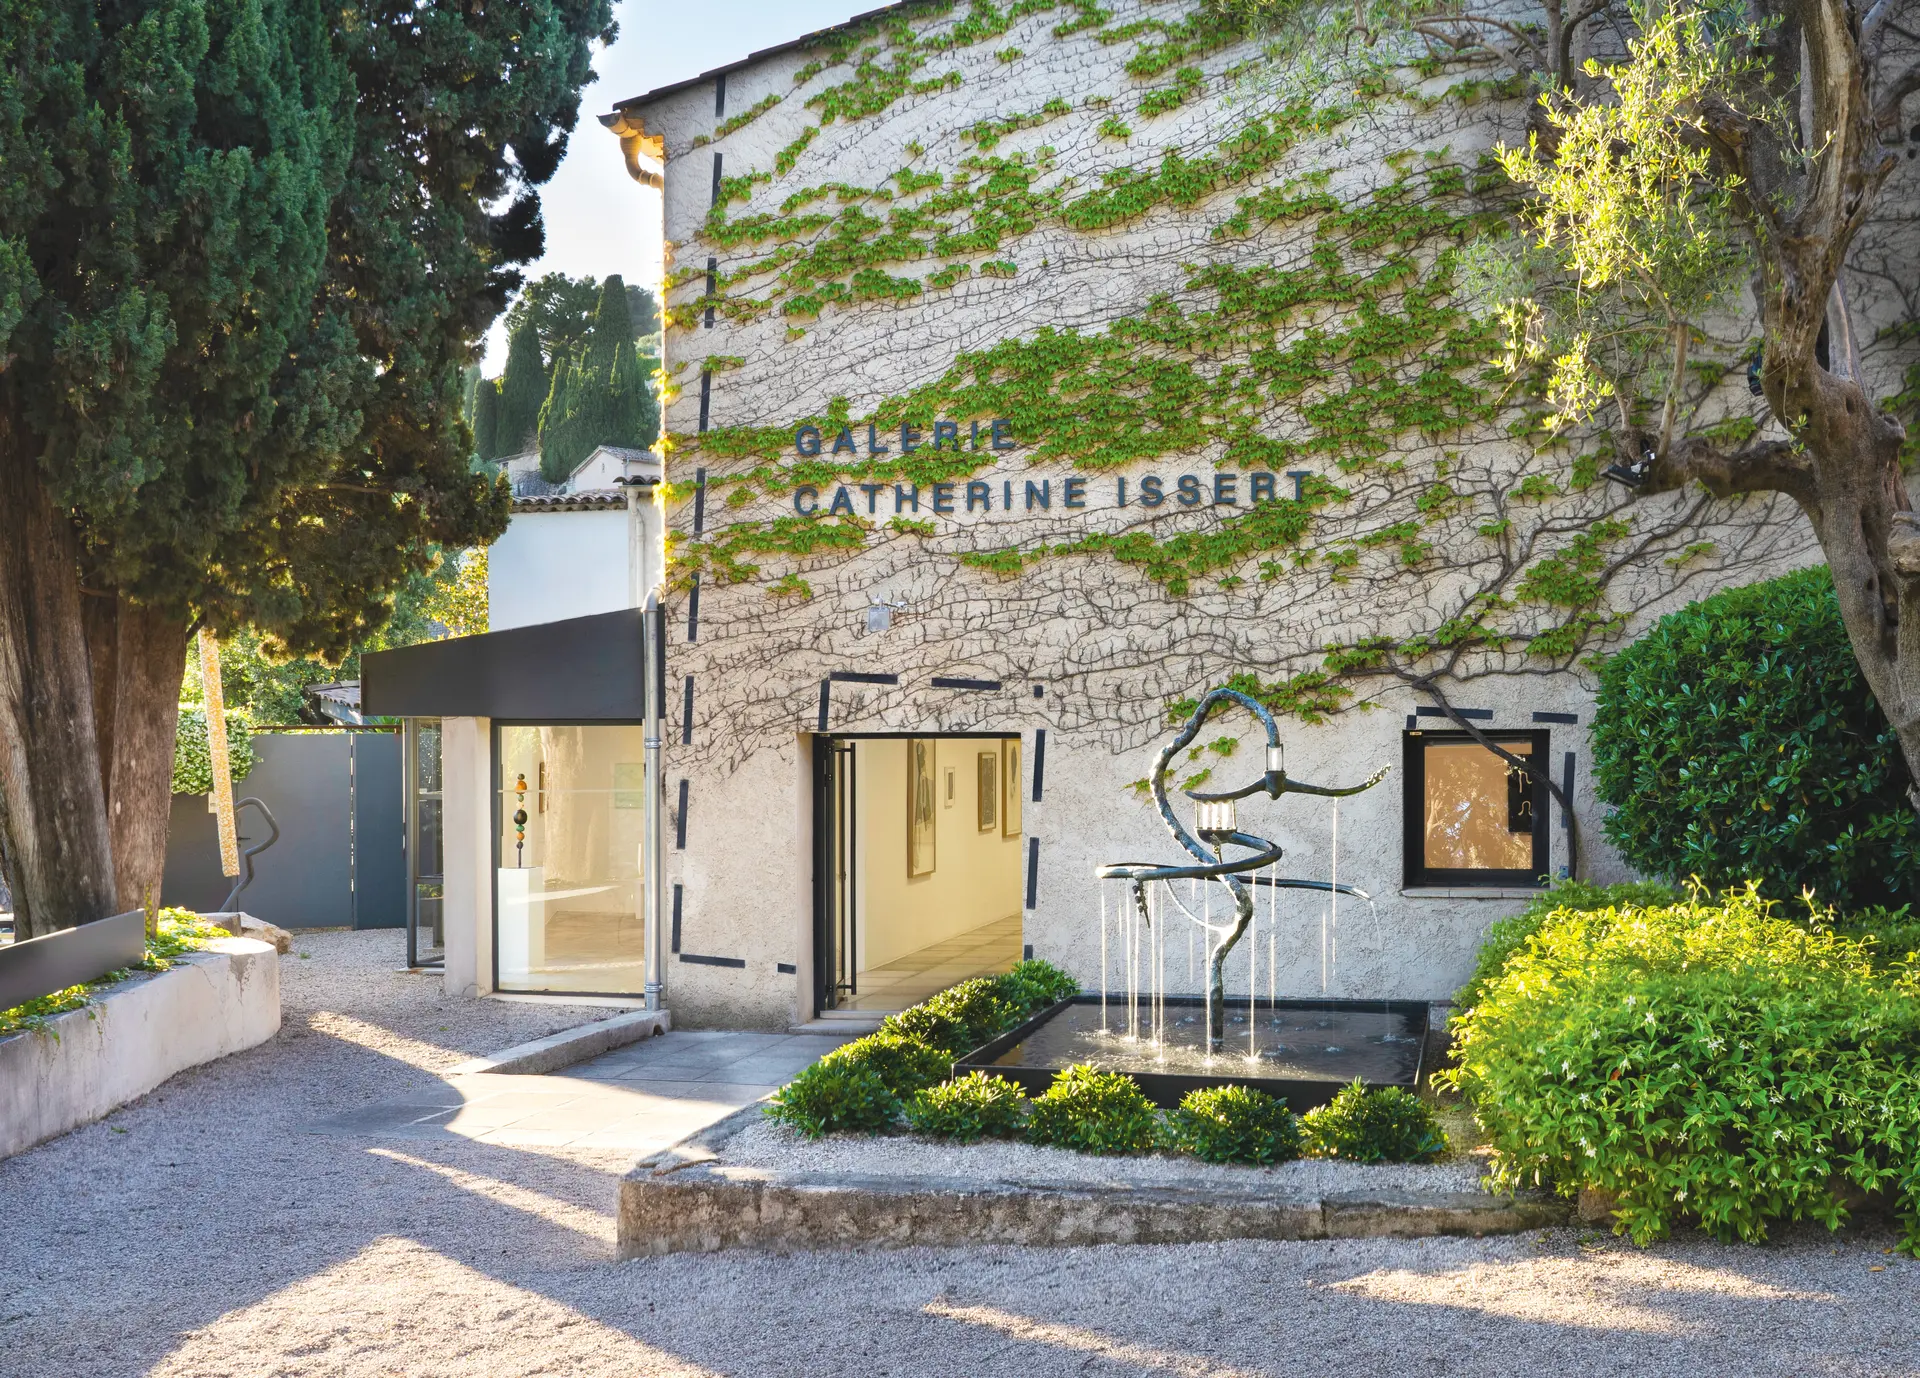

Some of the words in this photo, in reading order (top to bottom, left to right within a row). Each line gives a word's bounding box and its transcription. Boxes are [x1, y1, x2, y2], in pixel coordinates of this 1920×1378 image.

[795, 418, 1016, 456] GALERIE
[794, 477, 1087, 516] CATHERINE
[1117, 470, 1311, 508] ISSERT
